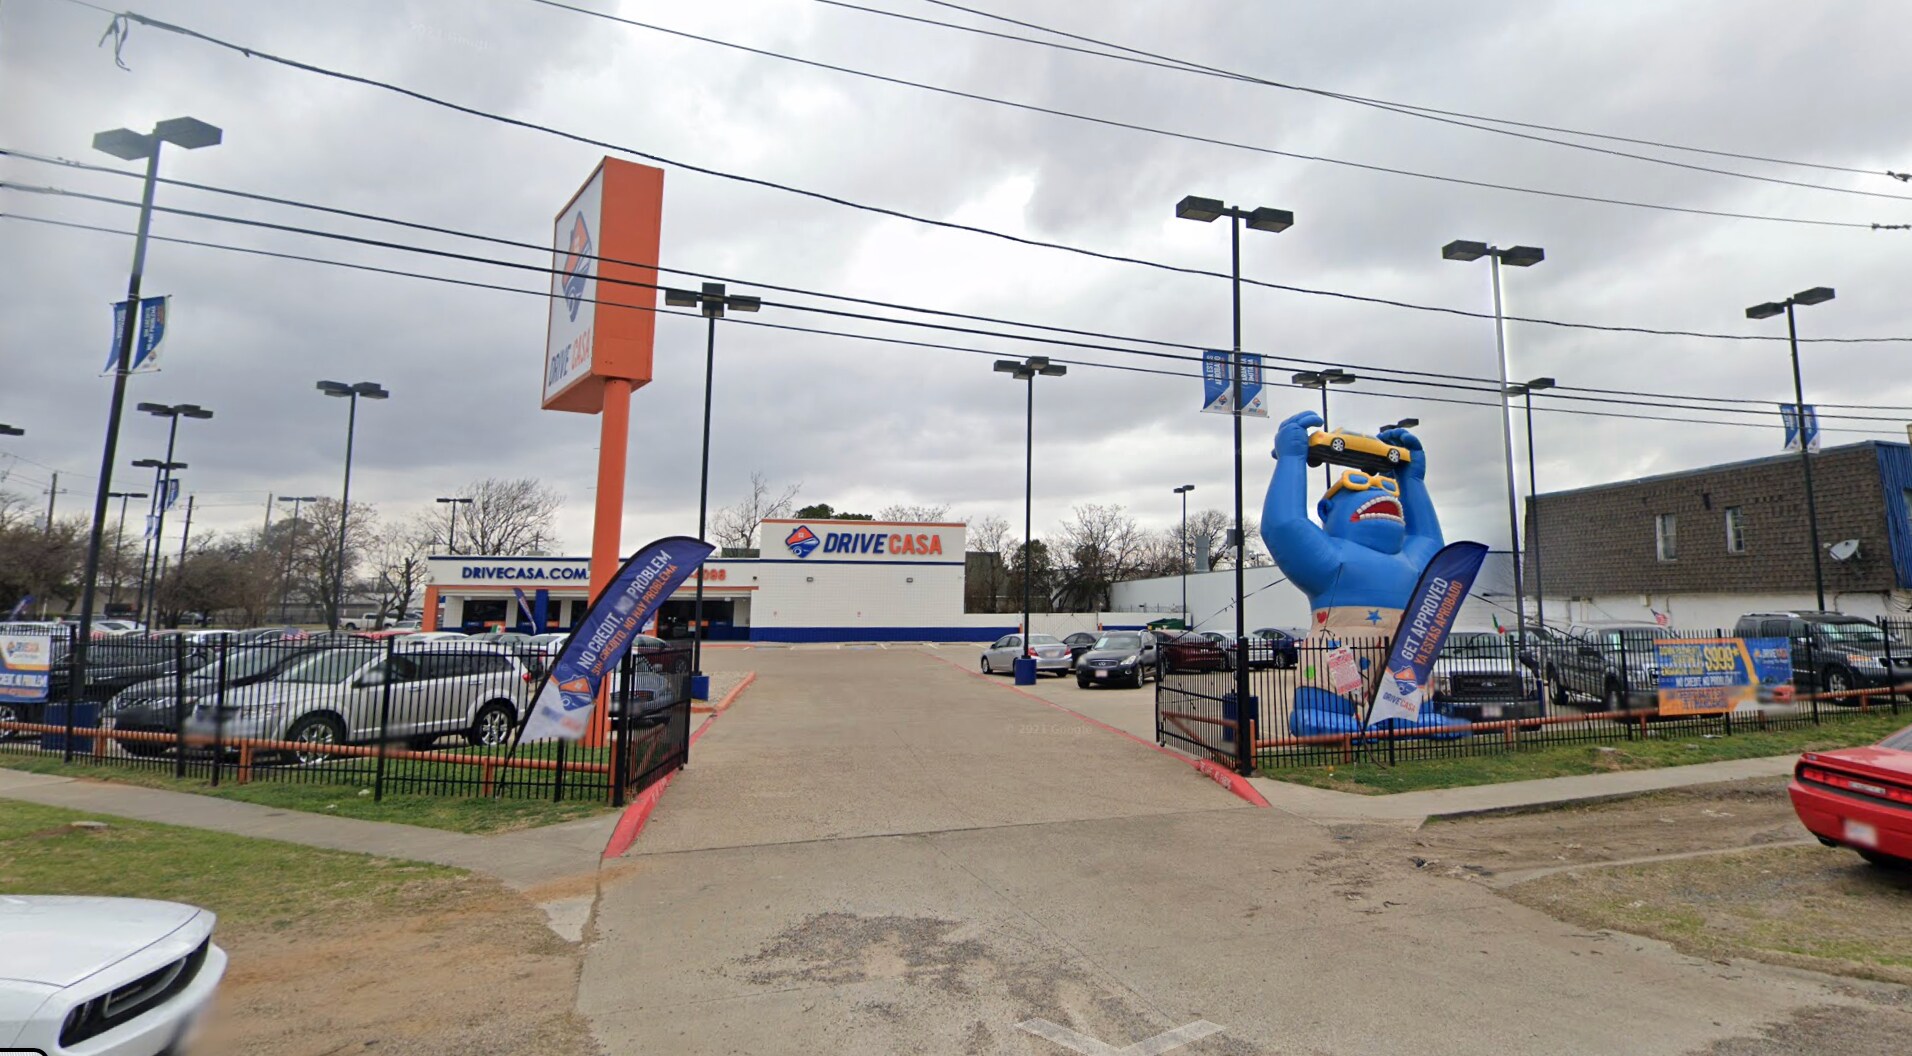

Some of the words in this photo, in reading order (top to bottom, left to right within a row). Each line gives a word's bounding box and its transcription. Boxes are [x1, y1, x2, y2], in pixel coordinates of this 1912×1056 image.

[549, 344, 571, 387] DRIVE
[571, 327, 590, 370] CASA
[462, 565, 588, 580] DRIVECASA.COM
[623, 616, 637, 631] NO
[632, 600, 648, 619] HAY
[643, 564, 678, 604] PROBLEMA
[576, 651, 597, 670] NO
[589, 612, 624, 652] CREDIT,
[627, 550, 672, 599] PROBLEM
[1410, 577, 1448, 638] APPROVED
[1414, 652, 1428, 666] YA
[1435, 580, 1463, 627] APROBADO
[1402, 636, 1420, 660] GET
